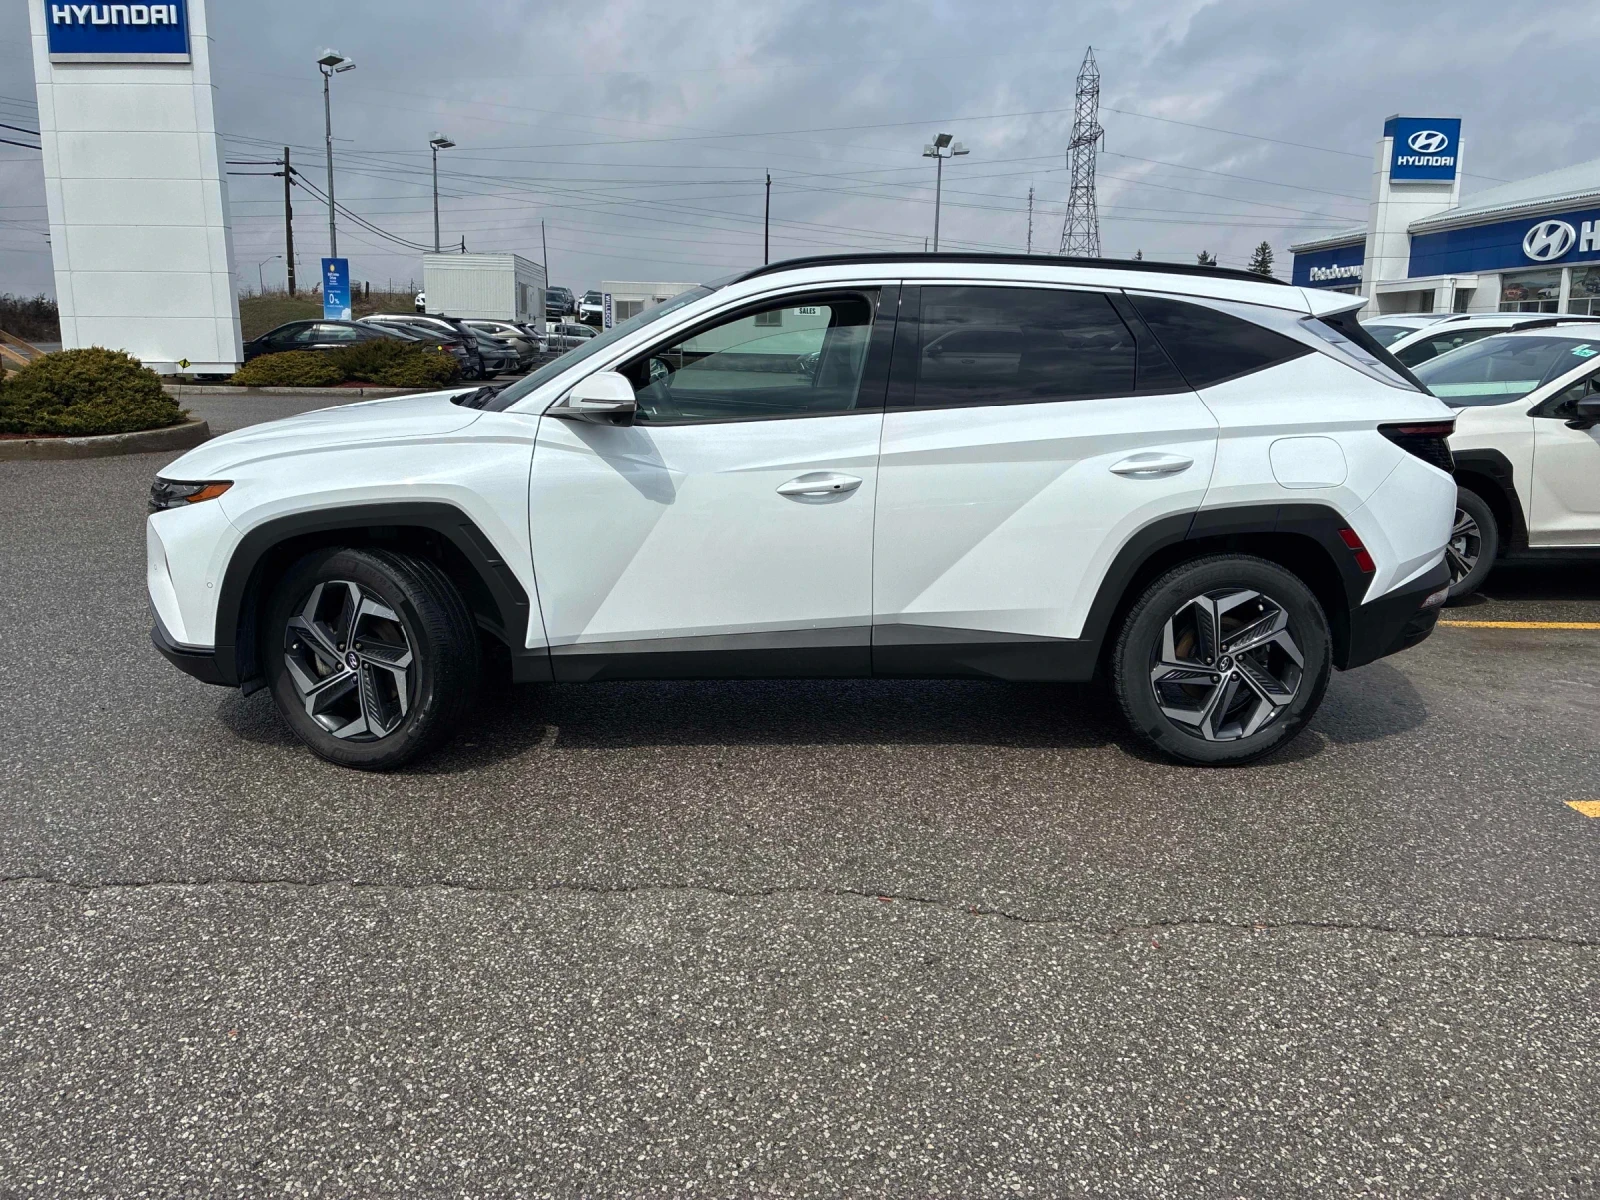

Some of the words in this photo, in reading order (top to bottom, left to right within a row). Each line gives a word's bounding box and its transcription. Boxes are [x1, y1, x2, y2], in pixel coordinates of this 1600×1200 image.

[52, 4, 178, 25] HYUNDAI
[1397, 156, 1454, 167] HYUNDAI
[799, 307, 816, 315] SALES
